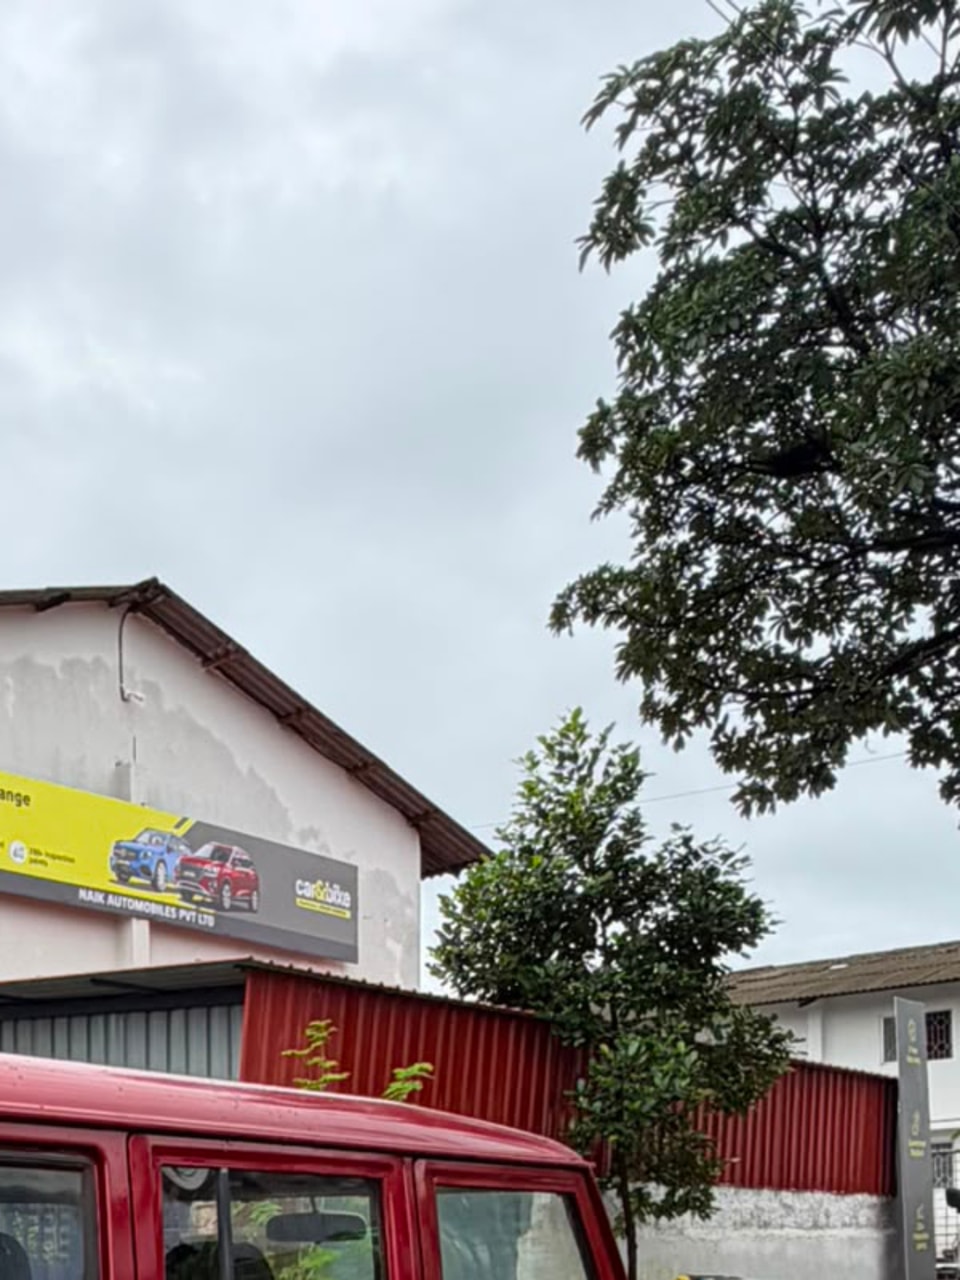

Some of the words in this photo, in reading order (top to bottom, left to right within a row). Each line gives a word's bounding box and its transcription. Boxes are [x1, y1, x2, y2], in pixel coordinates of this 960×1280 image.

[78, 888, 104, 904] NAIK
[106, 894, 177, 919] AUTOMOBILES
[180, 909, 196, 923] PVT
[199, 913, 216, 927] LTD
[295, 880, 351, 908] car&bike
